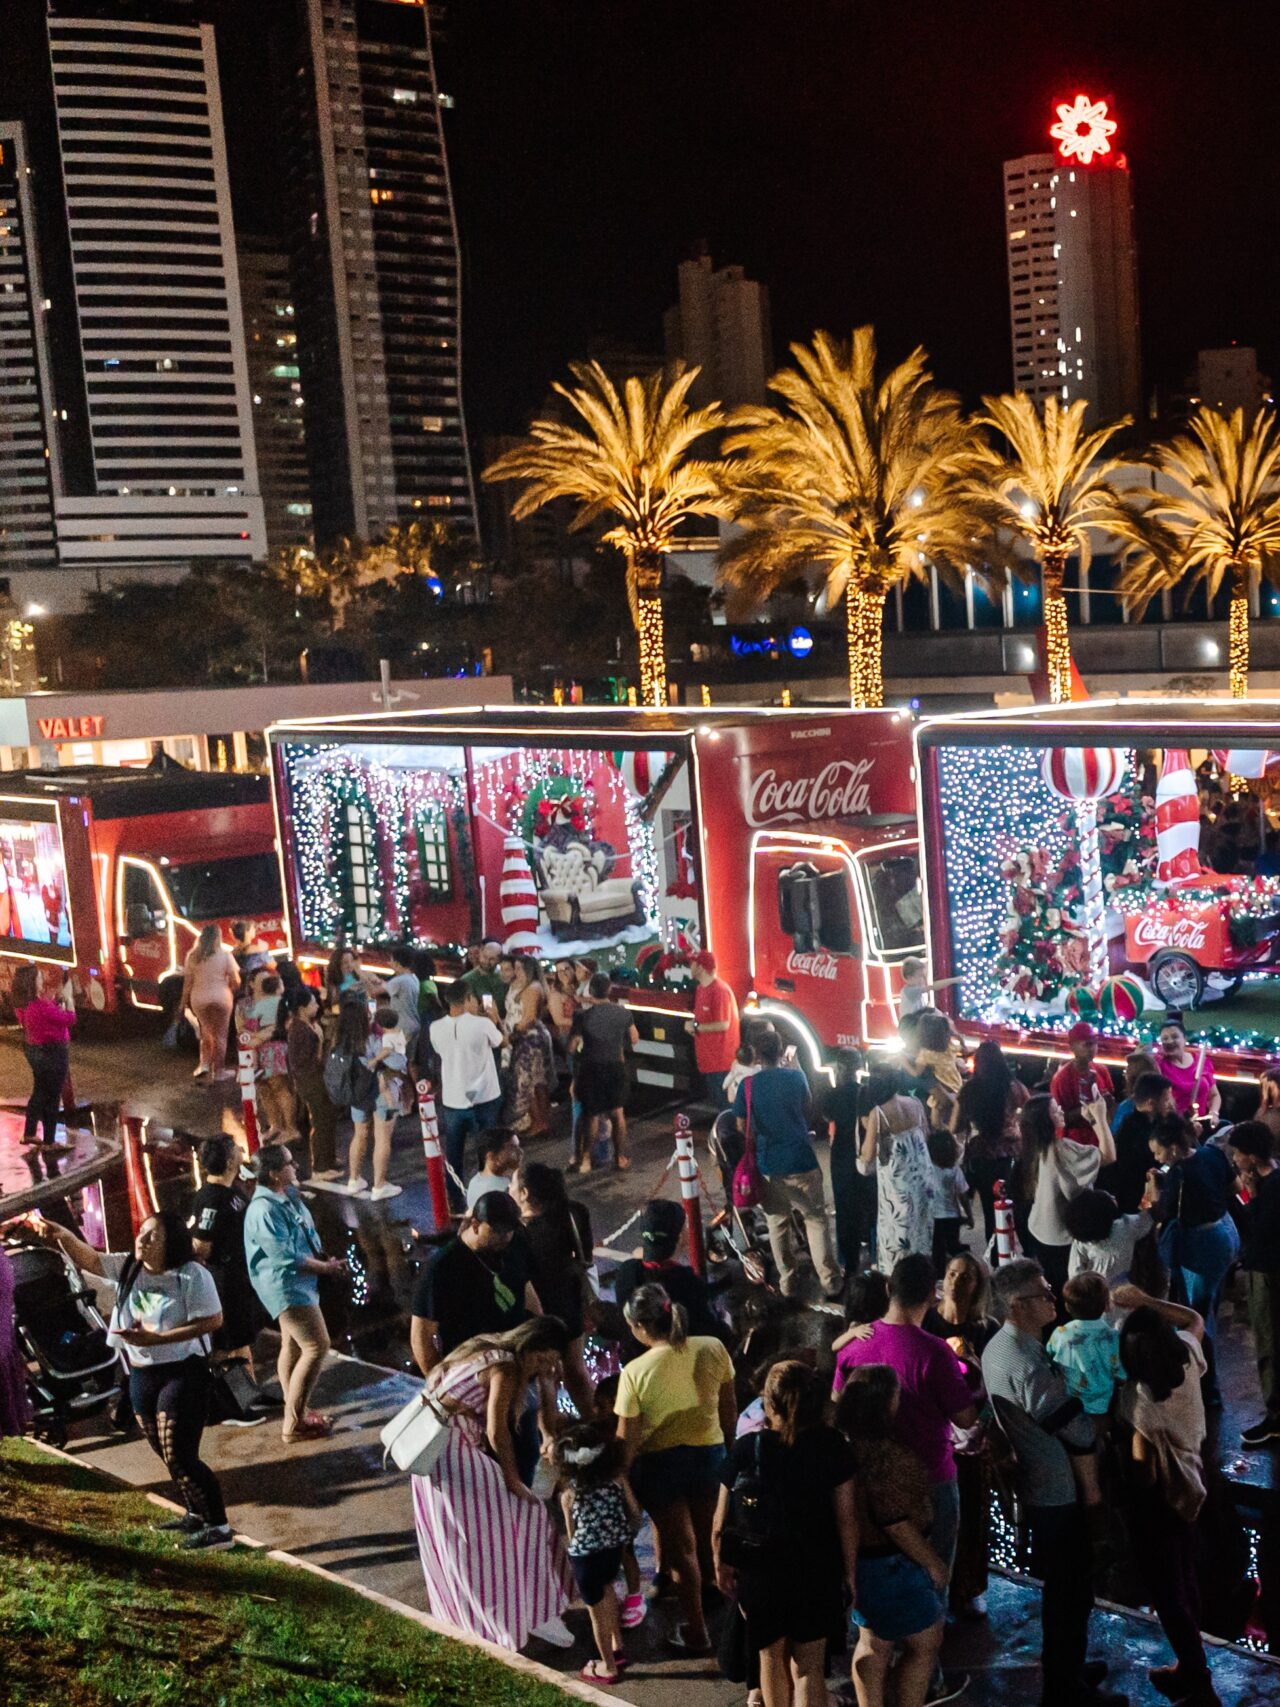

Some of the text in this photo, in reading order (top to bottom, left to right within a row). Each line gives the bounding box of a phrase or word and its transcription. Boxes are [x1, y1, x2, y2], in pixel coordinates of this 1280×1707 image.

[38, 716, 103, 739] VALET
[744, 758, 876, 828] Coca-Cola
[1133, 916, 1210, 950] Coca-Cola
[786, 949, 839, 979] Coca-Cola
